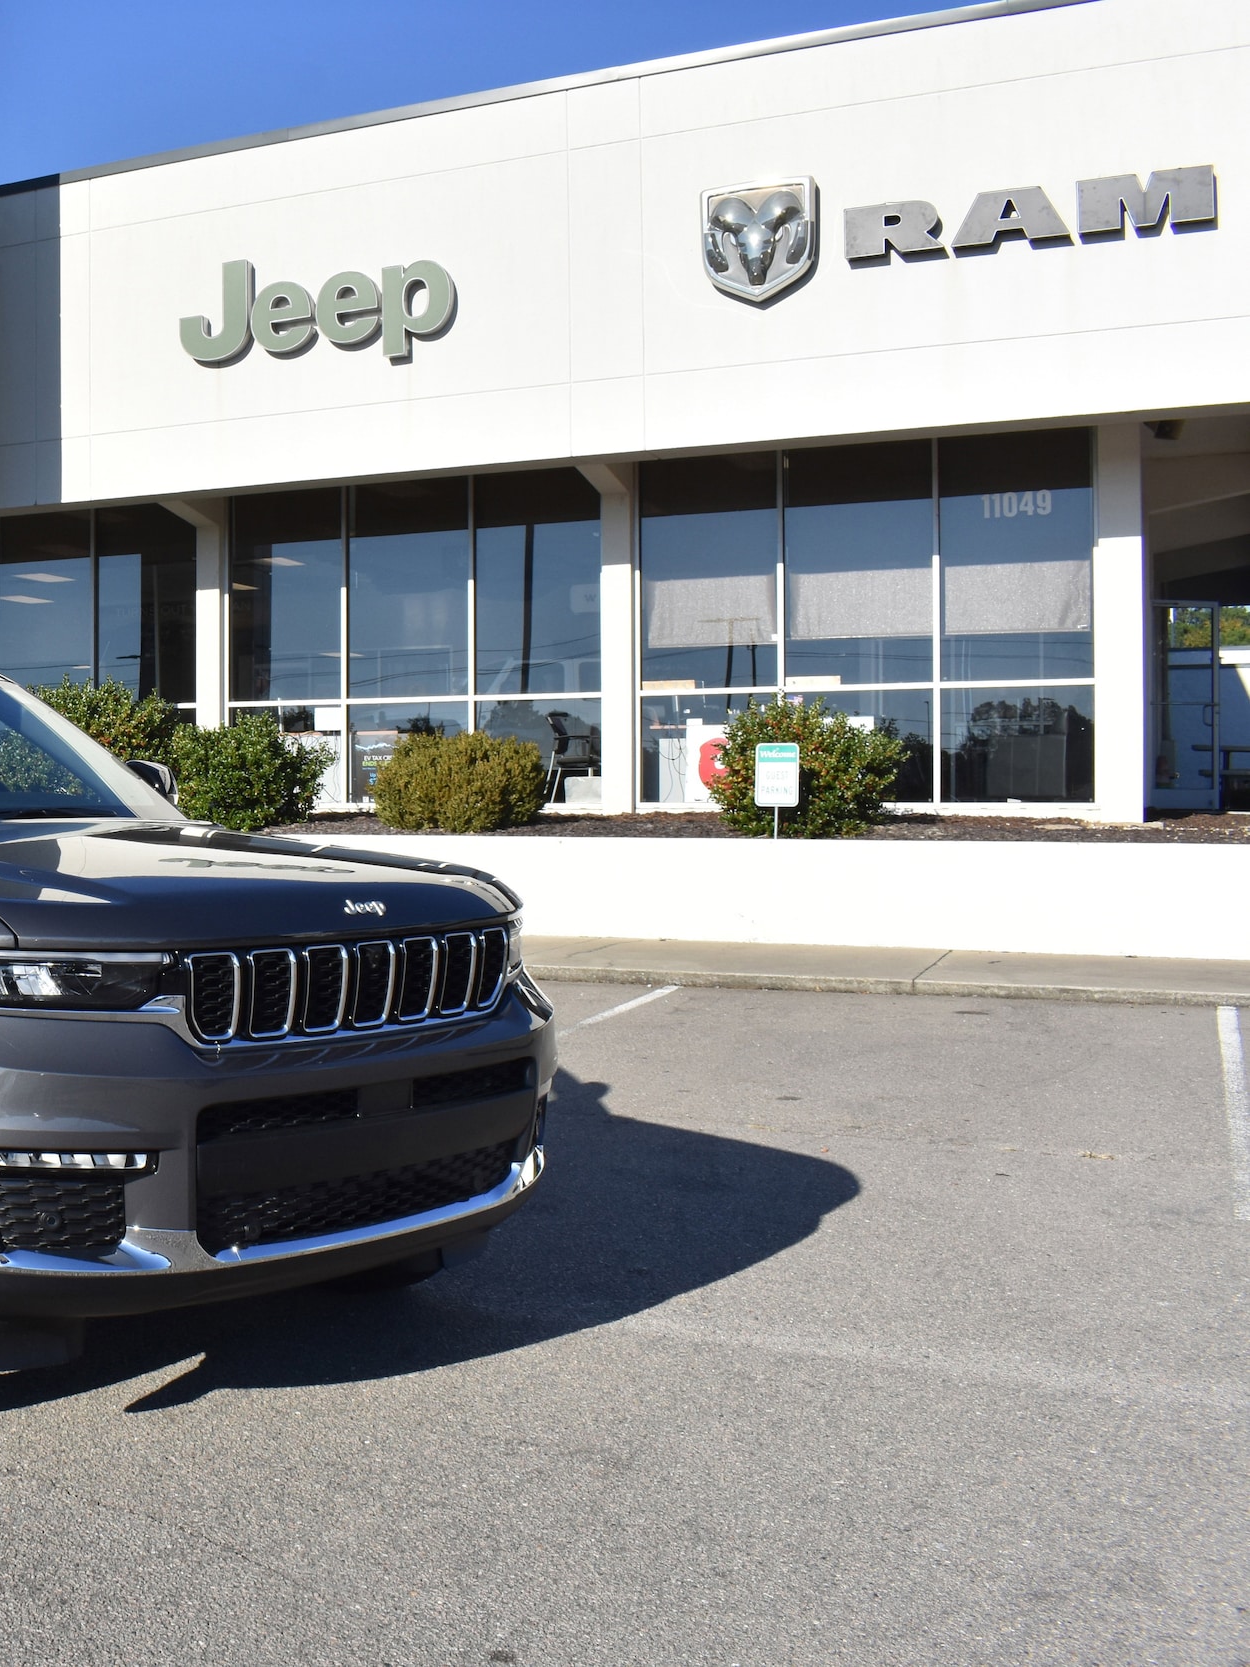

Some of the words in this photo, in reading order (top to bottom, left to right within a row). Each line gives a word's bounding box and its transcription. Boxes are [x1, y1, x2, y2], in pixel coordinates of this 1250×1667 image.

[843, 164, 1217, 269] RAM
[179, 259, 458, 367] Jeep
[981, 489, 1052, 519] 11049
[343, 899, 386, 917] Jeep
